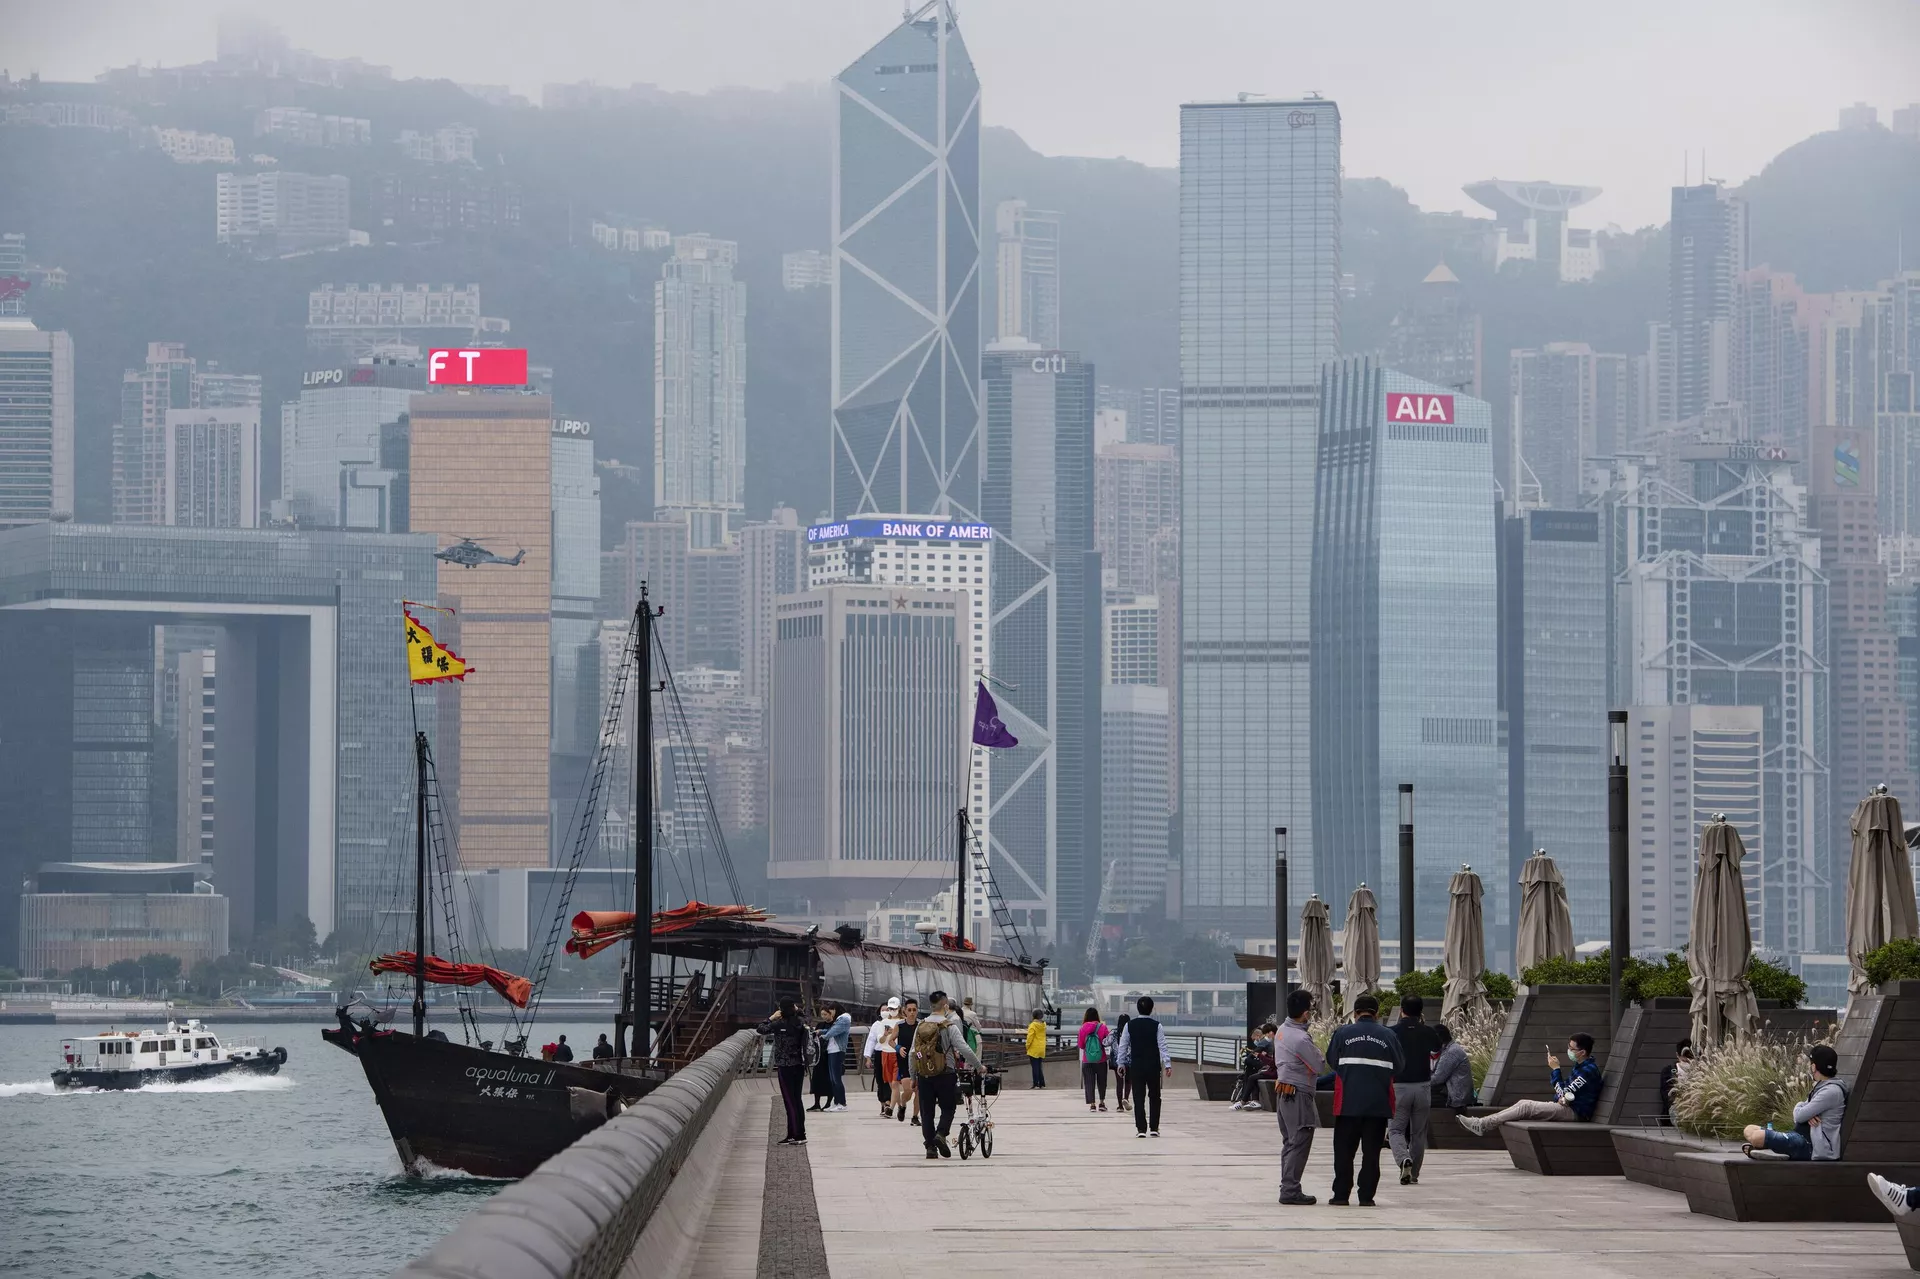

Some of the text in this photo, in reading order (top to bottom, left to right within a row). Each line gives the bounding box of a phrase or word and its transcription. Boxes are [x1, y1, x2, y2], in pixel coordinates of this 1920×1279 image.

[303, 369, 343, 385] LIPPO
[1395, 396, 1447, 421] AIA
[551, 419, 591, 435] LIPPO
[1728, 446, 1766, 459] HSBC
[808, 524, 850, 541] OF AMERICA
[882, 523, 922, 537] BANK
[926, 525, 945, 537] OF
[1344, 1034, 1388, 1049] General Security
[465, 1065, 540, 1086] aqualuna
